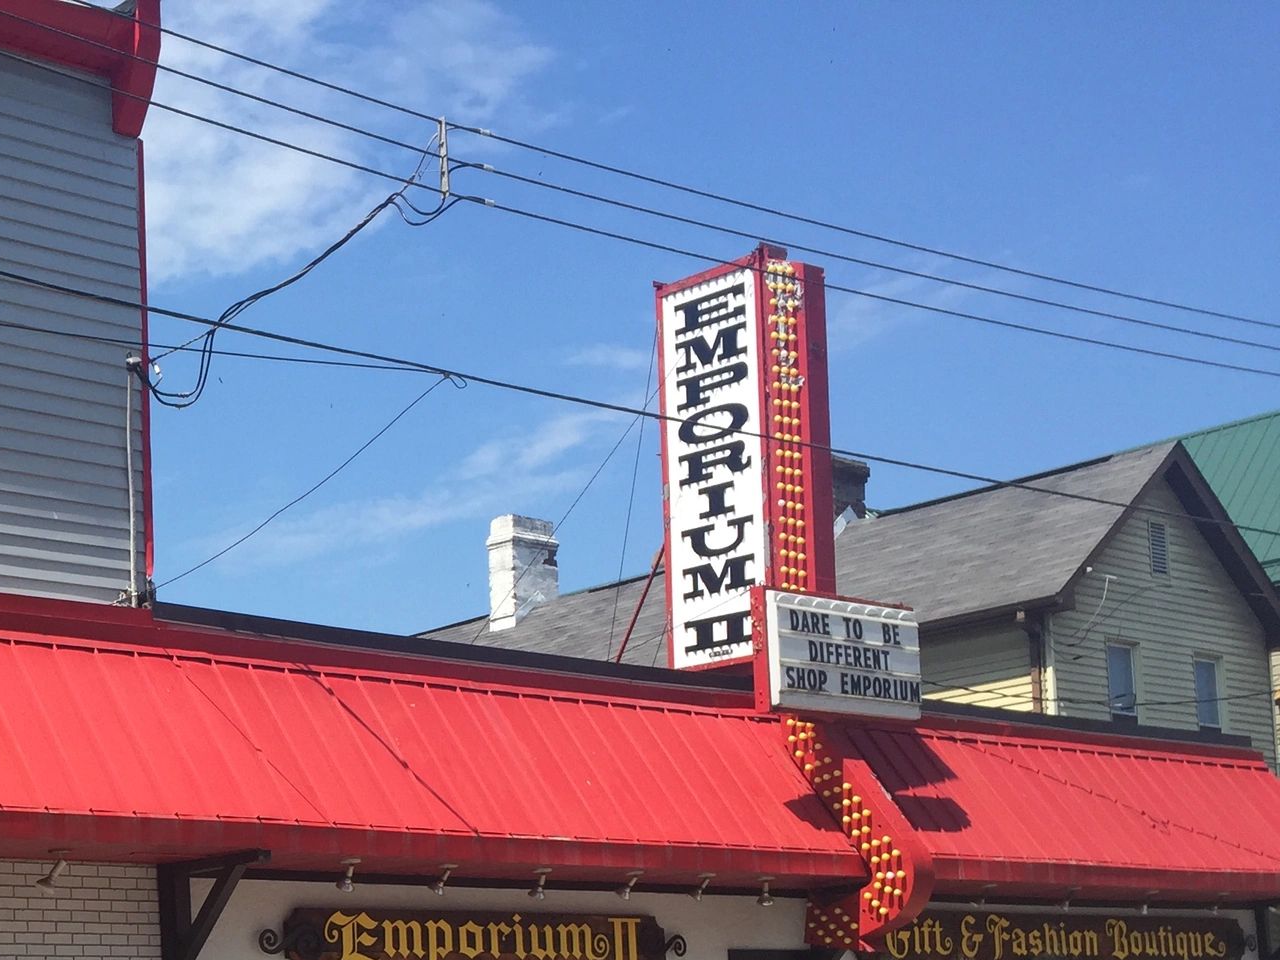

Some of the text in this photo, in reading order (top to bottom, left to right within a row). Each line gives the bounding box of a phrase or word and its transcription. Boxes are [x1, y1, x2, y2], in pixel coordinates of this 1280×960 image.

[674, 282, 756, 602] EMPORIUM
[684, 609, 753, 655] II
[789, 608, 901, 646] DARE TO BE
[808, 640, 890, 672] DIFFERENT
[785, 665, 920, 702] SHOP EMPORIUM
[961, 915, 984, 958] &
[986, 914, 1099, 960] Fashion
[1105, 918, 1226, 960] Boutique
